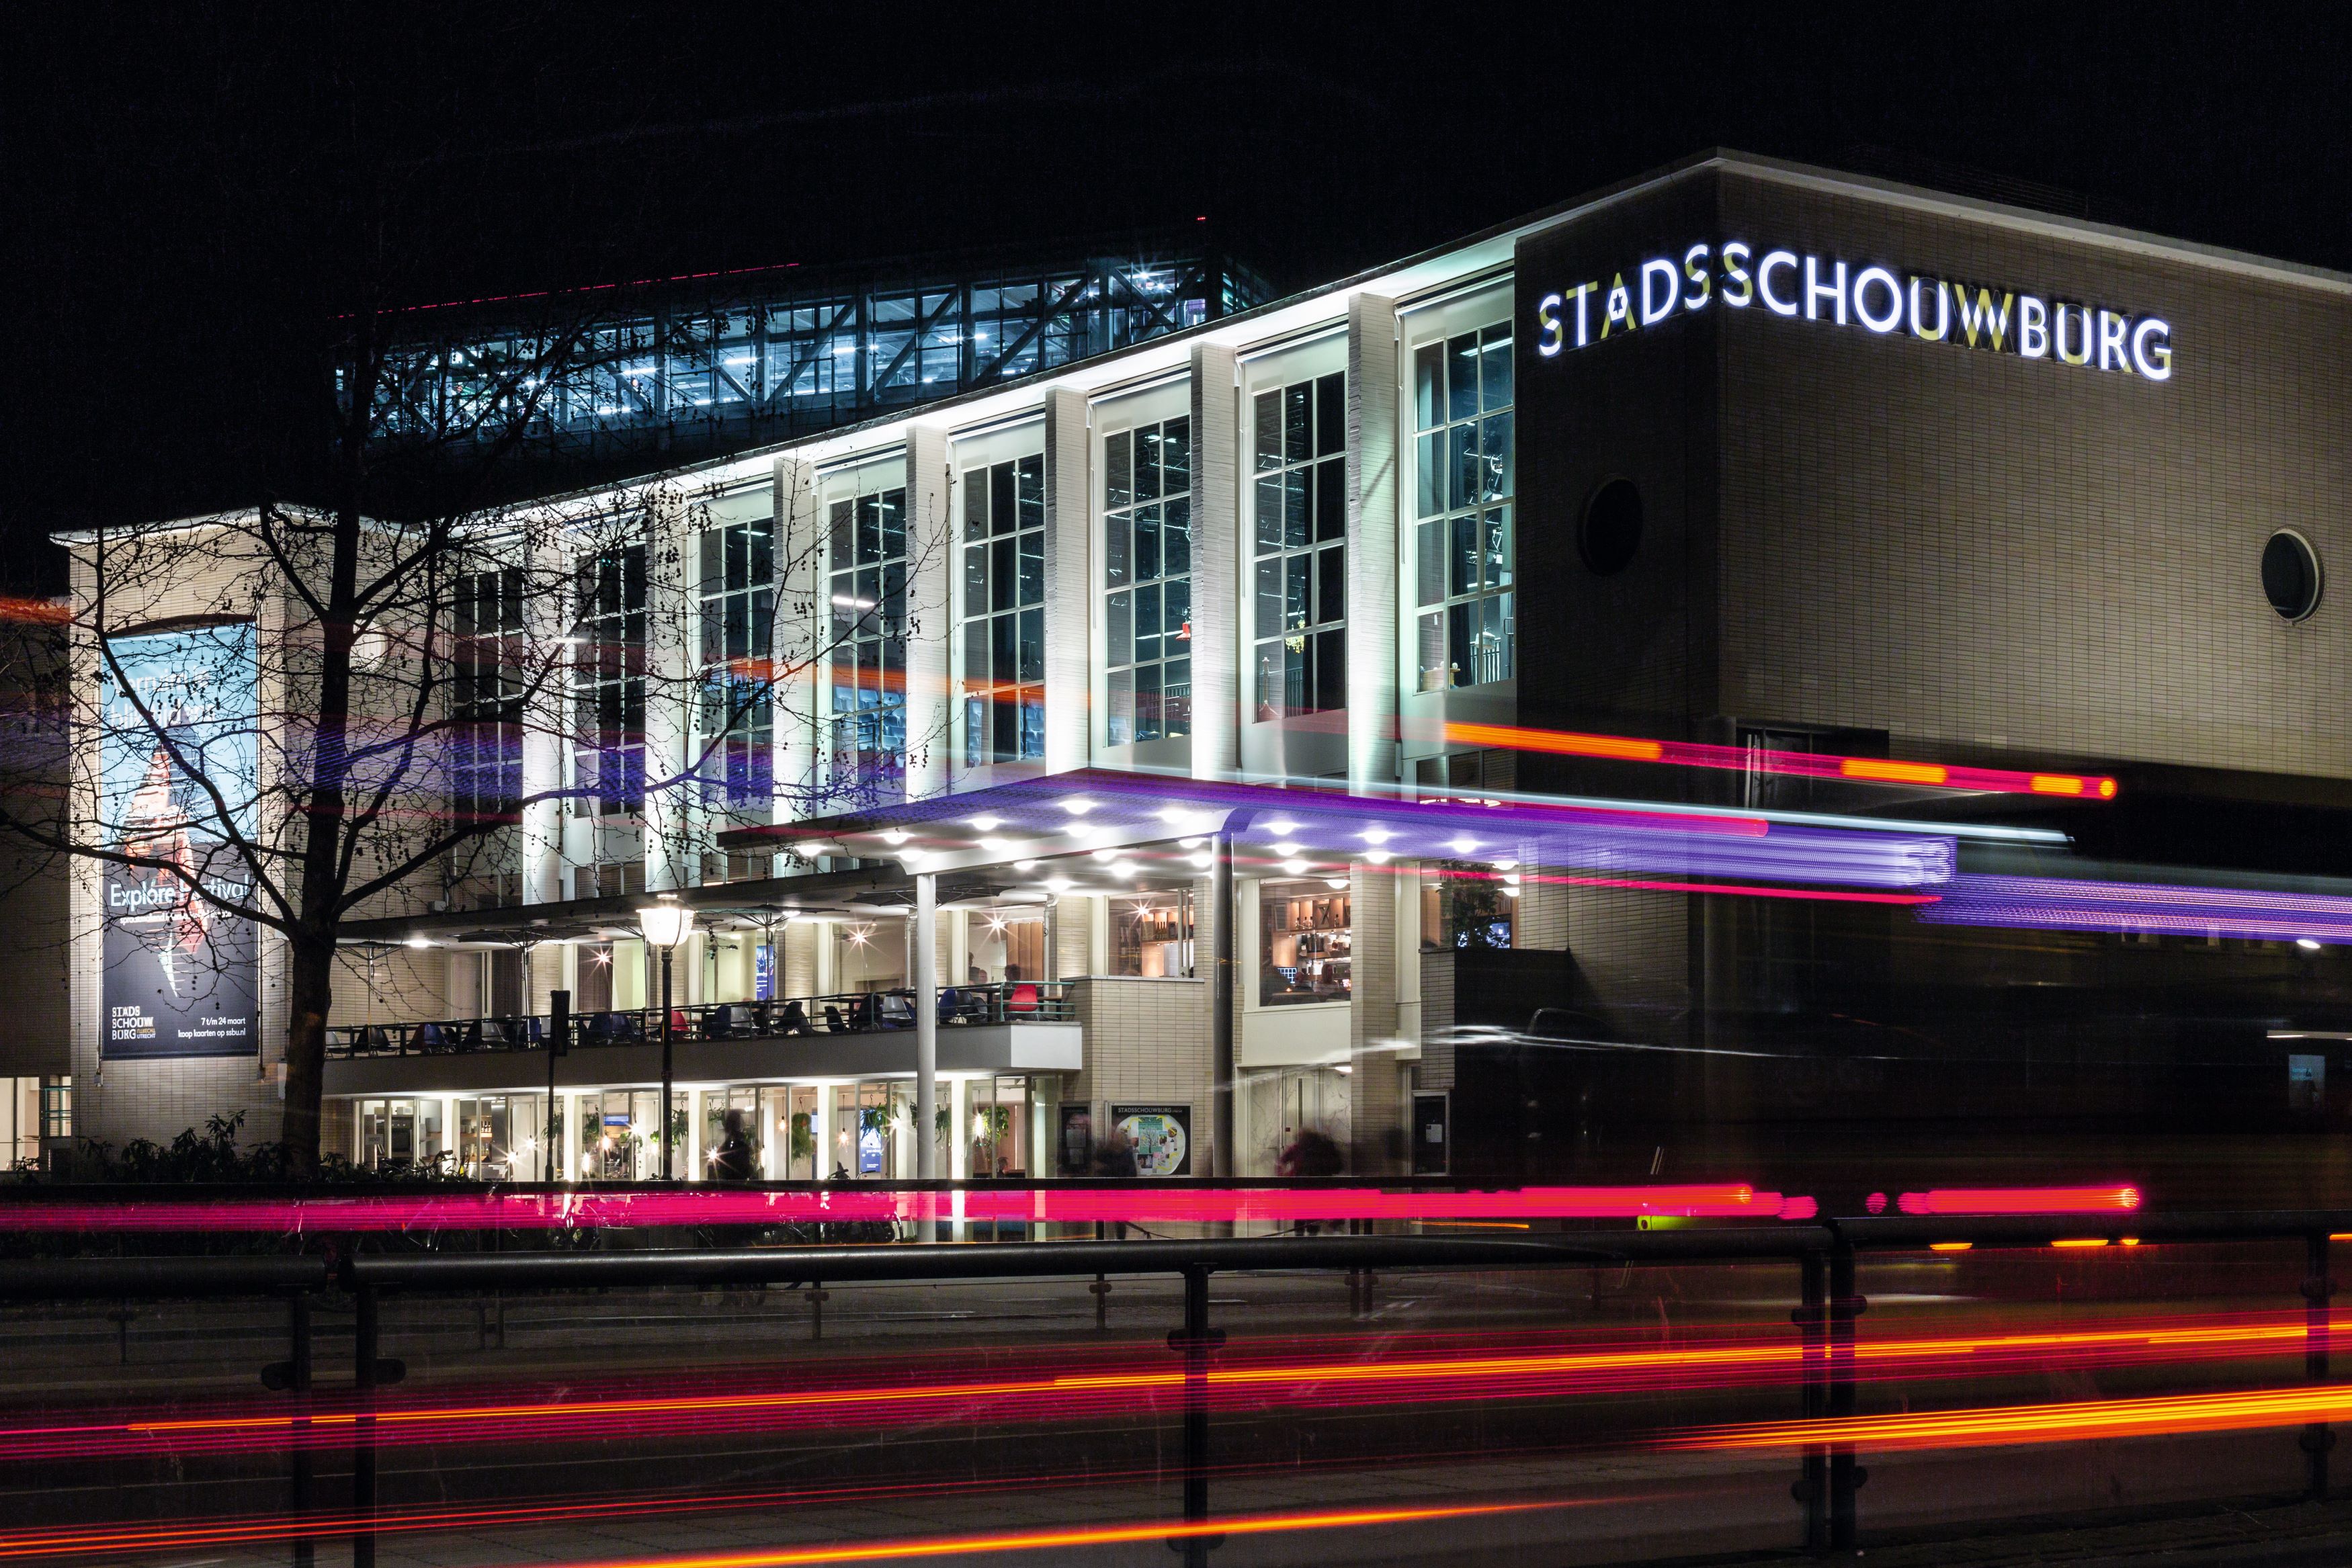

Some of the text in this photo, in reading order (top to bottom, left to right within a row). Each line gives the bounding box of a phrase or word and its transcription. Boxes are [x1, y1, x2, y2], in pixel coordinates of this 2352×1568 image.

[110, 873, 249, 911] Explore Ftival
[112, 1006, 140, 1018] STADS
[201, 1017, 206, 1026] 7
[206, 1017, 218, 1026] t/m
[218, 1016, 226, 1025] 24
[112, 1029, 136, 1040] BURG
[178, 1029, 193, 1039] koop
[194, 1029, 216, 1037] kaarten
[226, 1027, 246, 1037] ssbu.nl
